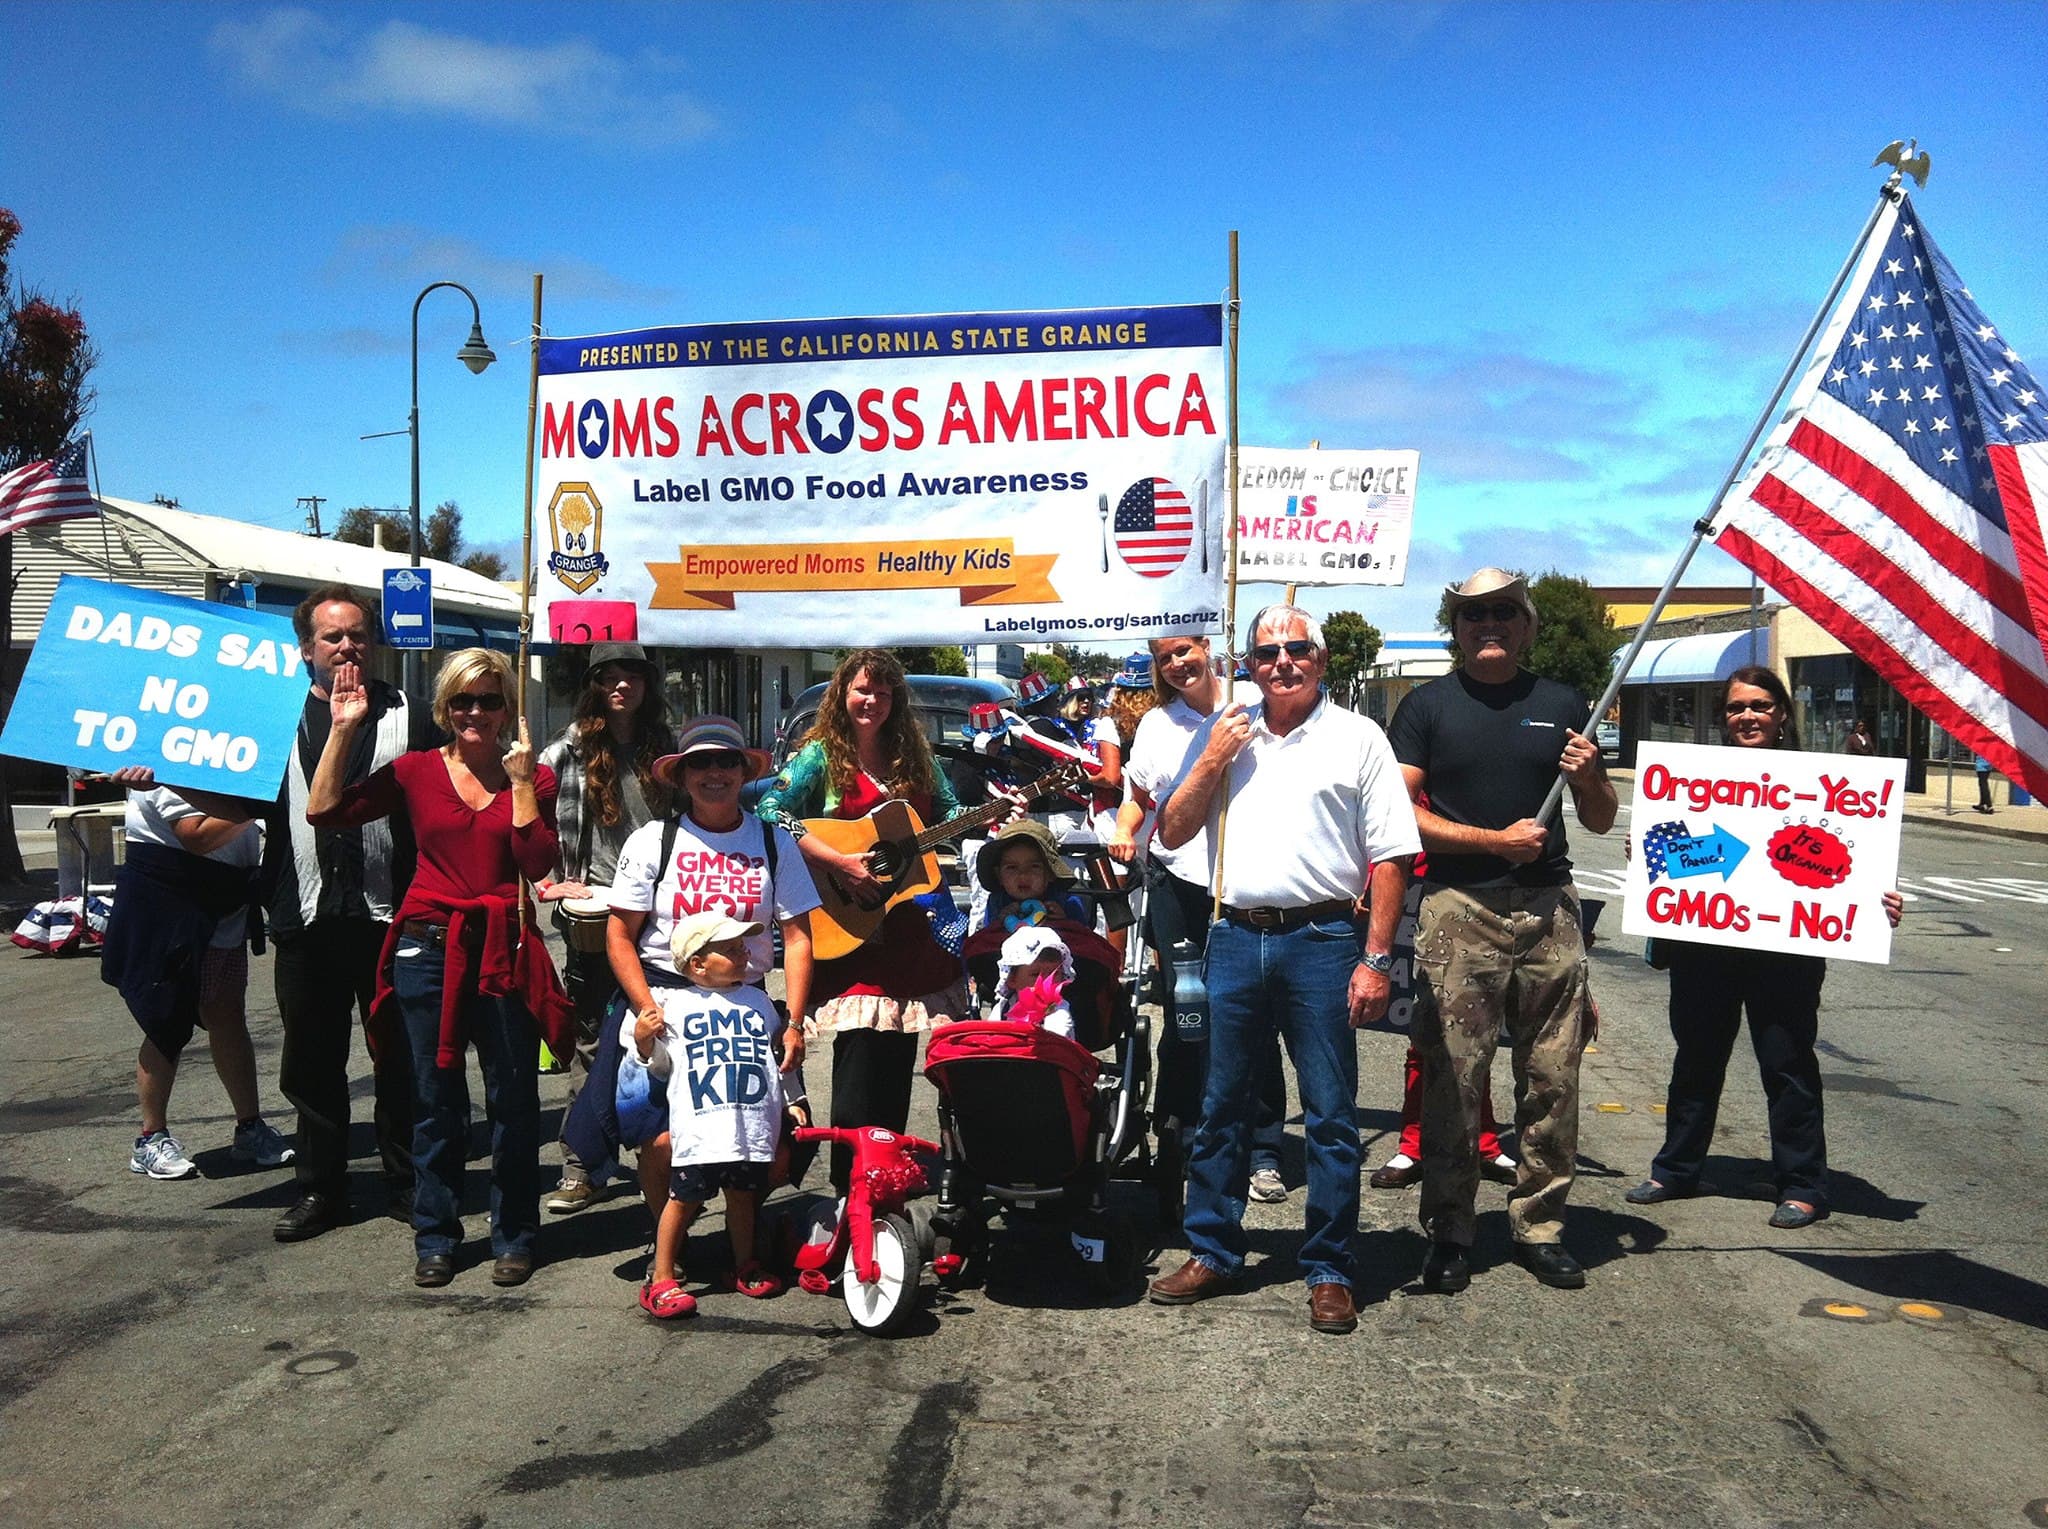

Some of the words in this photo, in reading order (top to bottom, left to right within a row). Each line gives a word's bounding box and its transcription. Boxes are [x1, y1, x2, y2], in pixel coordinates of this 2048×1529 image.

[580, 343, 678, 367] PRESENTED
[688, 341, 712, 361] BY
[723, 338, 768, 358] THE
[780, 330, 940, 356] CALIFORNIA
[951, 327, 1029, 349] STATE
[1041, 323, 1147, 346] GRANGE
[542, 396, 680, 459] MOMS
[696, 386, 925, 457] ACROSS
[938, 372, 1217, 446] AMERICA
[634, 478, 710, 503] Label
[720, 476, 794, 501] GMO
[806, 473, 886, 500] Food
[898, 471, 1089, 497] Awareness
[1329, 466, 1408, 495] CHOICE
[1285, 495, 1318, 517] IS
[1227, 515, 1379, 544] AMERICAN
[555, 556, 598, 571] GRANGE
[686, 553, 799, 579] Empowered
[805, 553, 865, 574] Moms
[877, 550, 957, 576] Healthy
[963, 548, 1011, 570] Kids
[1240, 551, 1307, 566] LABEL
[984, 611, 1218, 635] Labelgmos.org/santacruz
[65, 605, 202, 658] DADS
[216, 633, 302, 677] SAY
[139, 676, 209, 719] NO
[73, 709, 137, 752] TO
[161, 726, 259, 773] GMO
[676, 852, 764, 875] GMO?
[677, 872, 761, 895] WE'RE
[673, 892, 761, 922] NOT
[683, 1009, 766, 1040] GMO
[686, 1037, 768, 1069] FREE
[688, 1063, 767, 1110] KID
